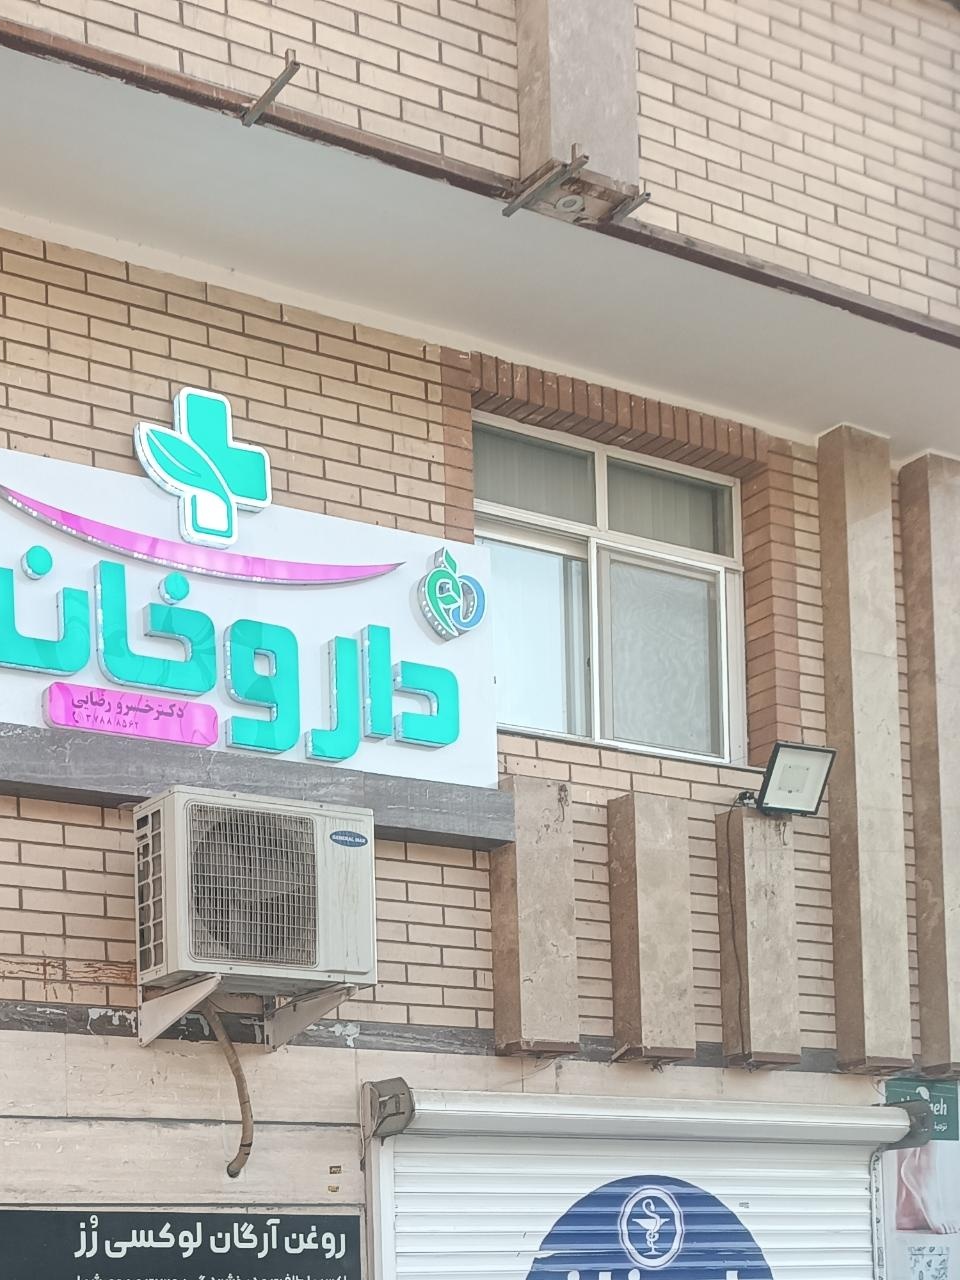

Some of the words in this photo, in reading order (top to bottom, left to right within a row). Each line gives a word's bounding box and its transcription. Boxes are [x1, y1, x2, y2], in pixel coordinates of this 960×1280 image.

[71, 690, 112, 713] رضایی
[105, 1222, 202, 1259] لوکسی
[209, 1218, 281, 1259] آرگان
[284, 1225, 346, 1259] روغن
